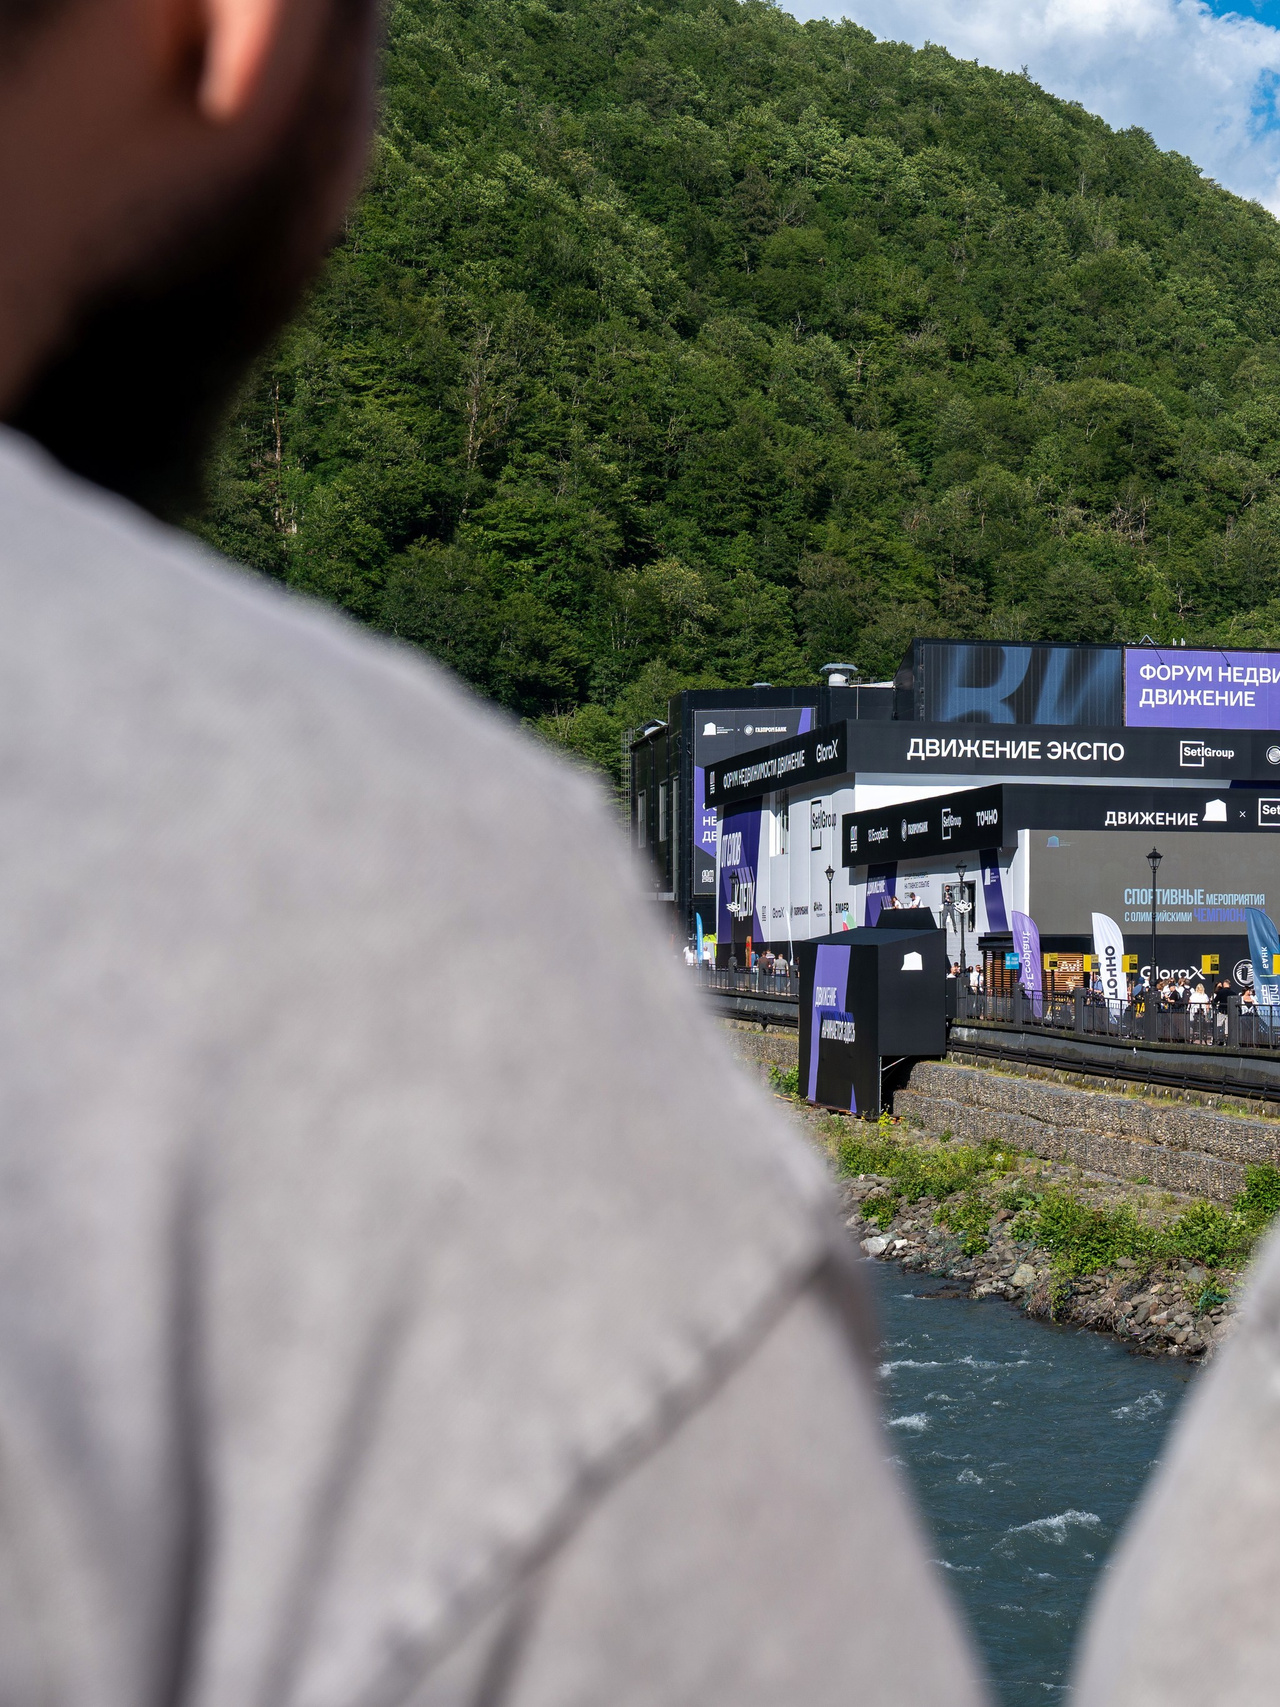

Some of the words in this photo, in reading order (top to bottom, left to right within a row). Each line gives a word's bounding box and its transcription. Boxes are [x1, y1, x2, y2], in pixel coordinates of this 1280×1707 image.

[1139, 664, 1212, 682] ФОРУМ
[1139, 688, 1255, 707] ДВИЖЕНИЕ
[816, 739, 839, 763] GloraX
[907, 738, 1041, 760] ДВИЖЕНИЕ
[1047, 741, 1125, 761] ЭКСПО
[722, 767, 739, 790] ФОРУМ
[738, 760, 777, 788] НЕДВИЖИМОСТИ
[777, 750, 806, 779] ДВИЖЕНИЕ
[976, 808, 998, 827] ТОЧНО
[1105, 811, 1198, 827] ДВИЖЕНИЕ
[1124, 888, 1204, 905] СПОРТИВНЫЕ
[1206, 893, 1265, 905] МЕРОПРИЯТИЯ
[1124, 912, 1129, 922] С
[1131, 910, 1192, 922] ОЛИМИЙСКИМИ
[1193, 908, 1265, 922] ЧЕМПИОНА
[1140, 966, 1206, 980] GloraX
